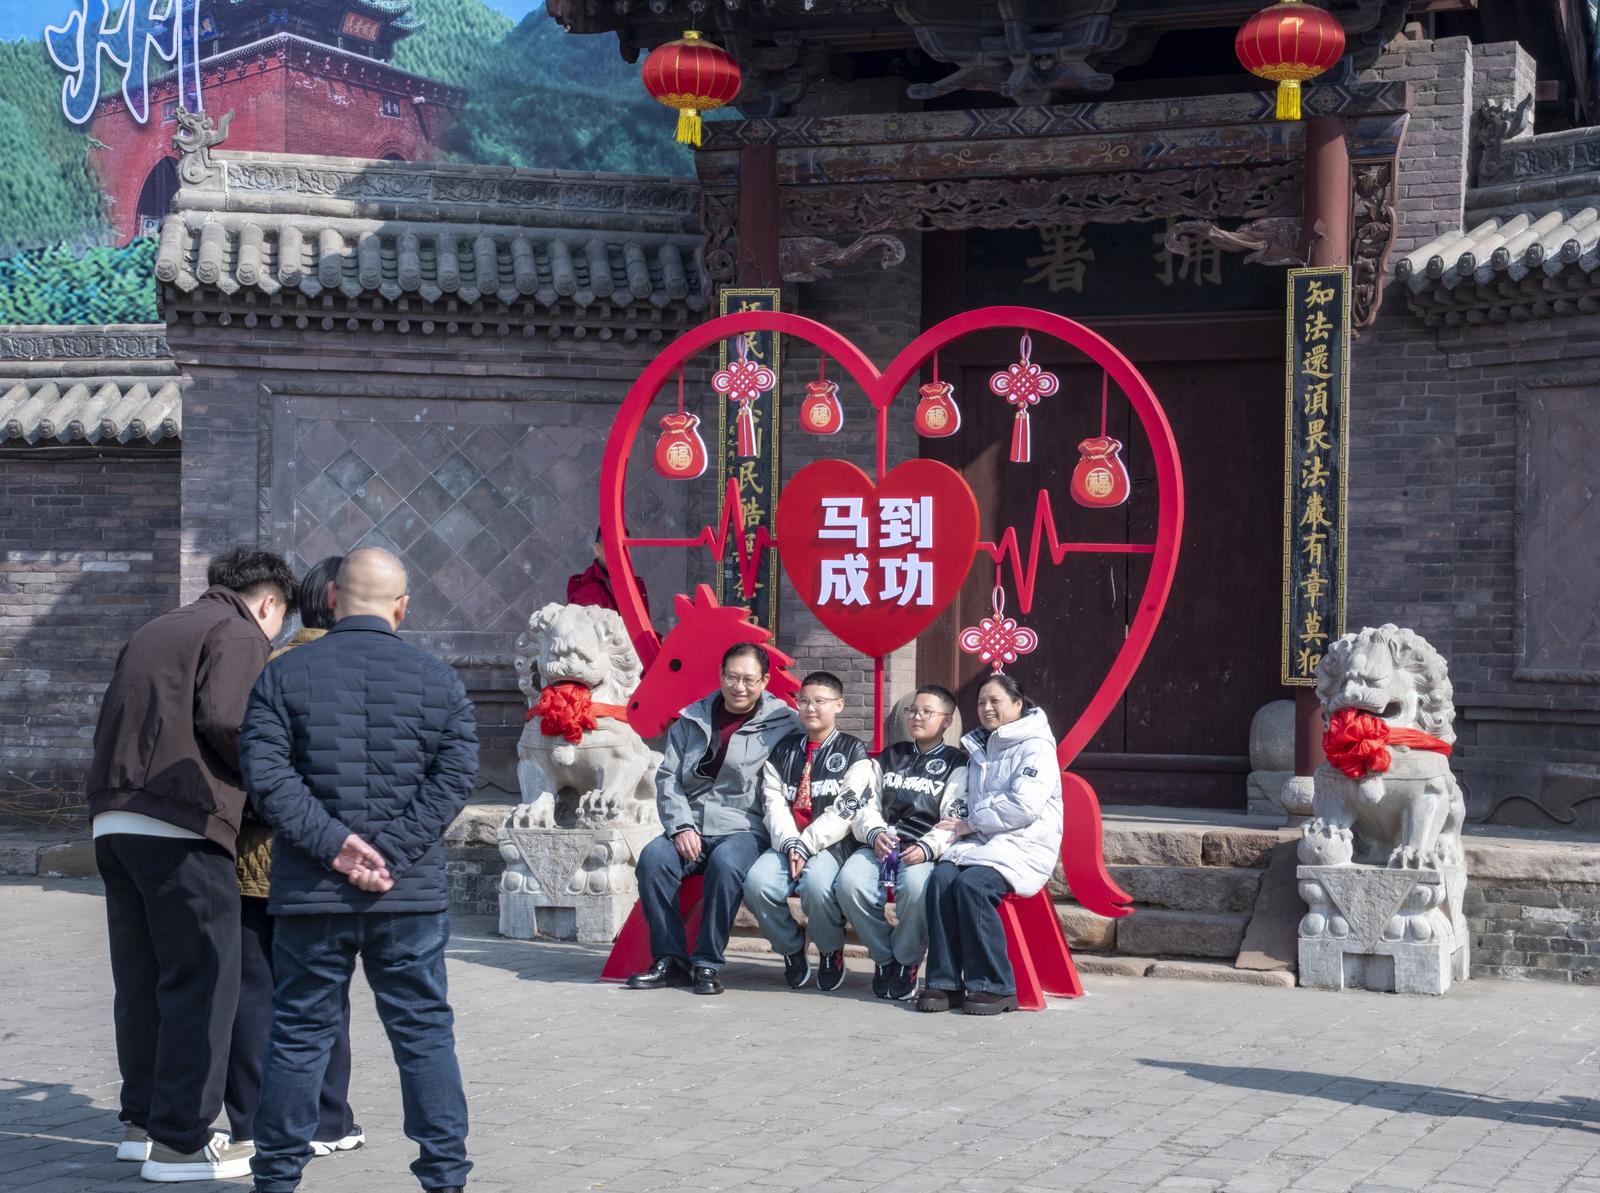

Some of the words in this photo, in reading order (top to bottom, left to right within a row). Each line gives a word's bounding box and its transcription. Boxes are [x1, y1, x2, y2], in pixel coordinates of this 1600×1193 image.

[811, 406, 830, 425] 福
[926, 408, 947, 428] 福
[668, 444, 691, 468] 福
[1087, 471, 1112, 495] 福
[818, 496, 933, 549] 马到
[817, 553, 934, 606] 成功
